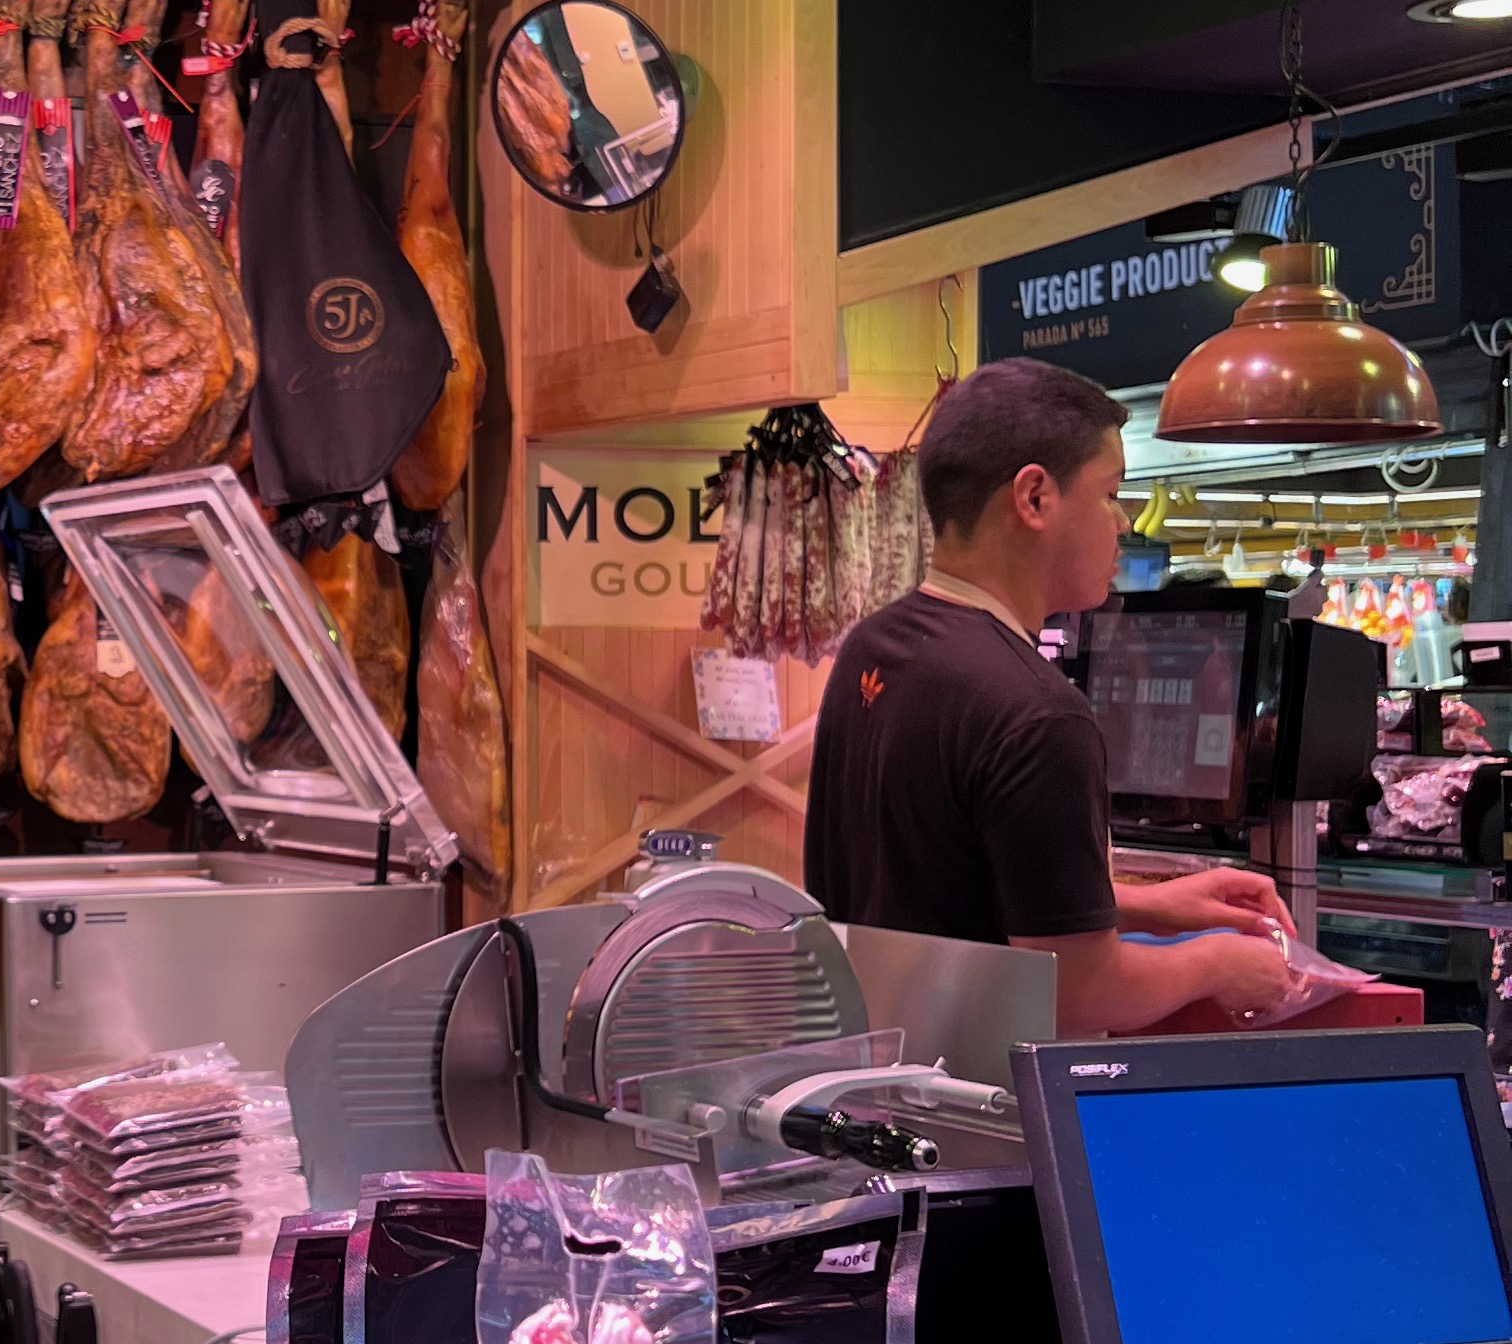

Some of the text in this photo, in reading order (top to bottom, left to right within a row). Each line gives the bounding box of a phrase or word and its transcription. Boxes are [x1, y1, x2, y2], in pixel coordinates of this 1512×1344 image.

[1018, 263, 1106, 320] VEGGIE
[323, 293, 363, 339] 5J
[1022, 323, 1068, 351] PARADA
[536, 485, 723, 545] MOL
[590, 561, 714, 598] GOU
